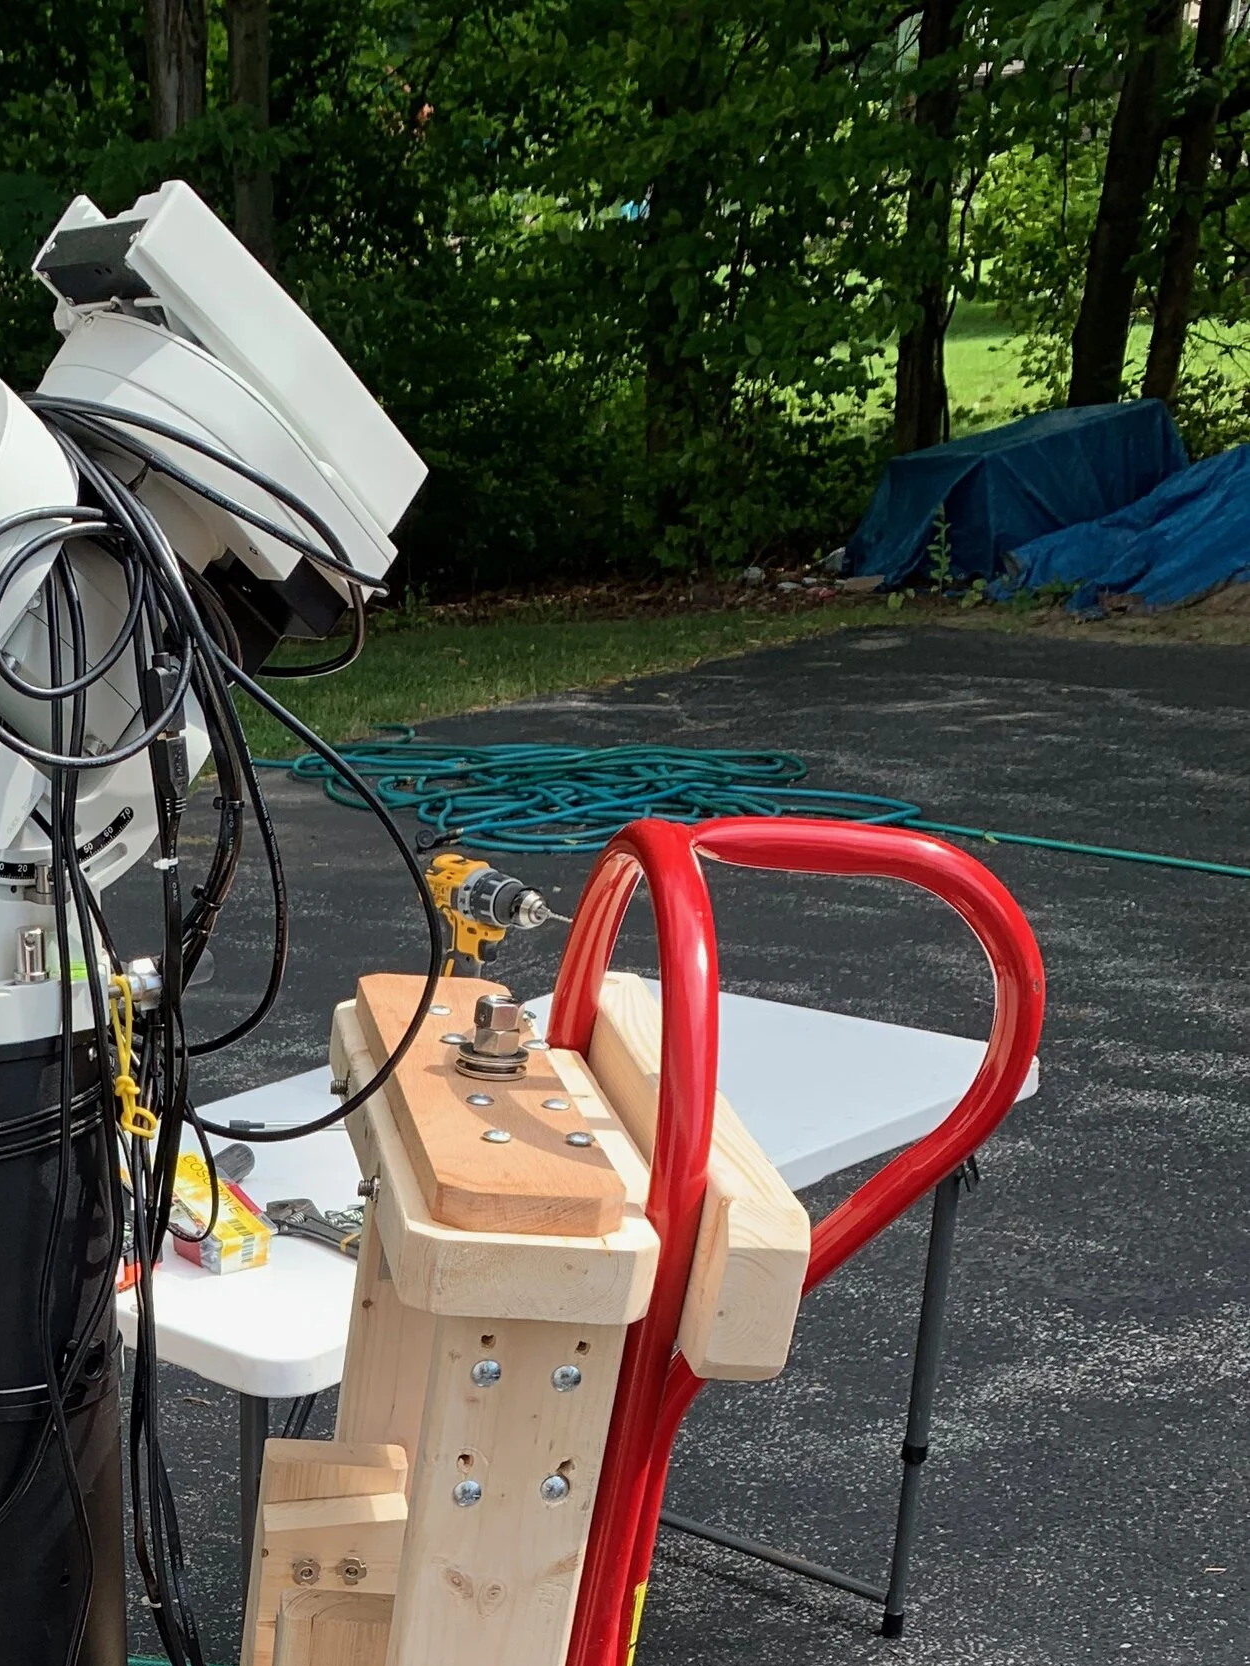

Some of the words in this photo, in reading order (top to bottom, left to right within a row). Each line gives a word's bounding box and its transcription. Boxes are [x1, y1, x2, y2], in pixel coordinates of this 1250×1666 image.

[120, 807, 131, 820] 70
[103, 826, 114, 838] 60
[83, 842, 94, 854] 50
[17, 864, 28, 873] 20
